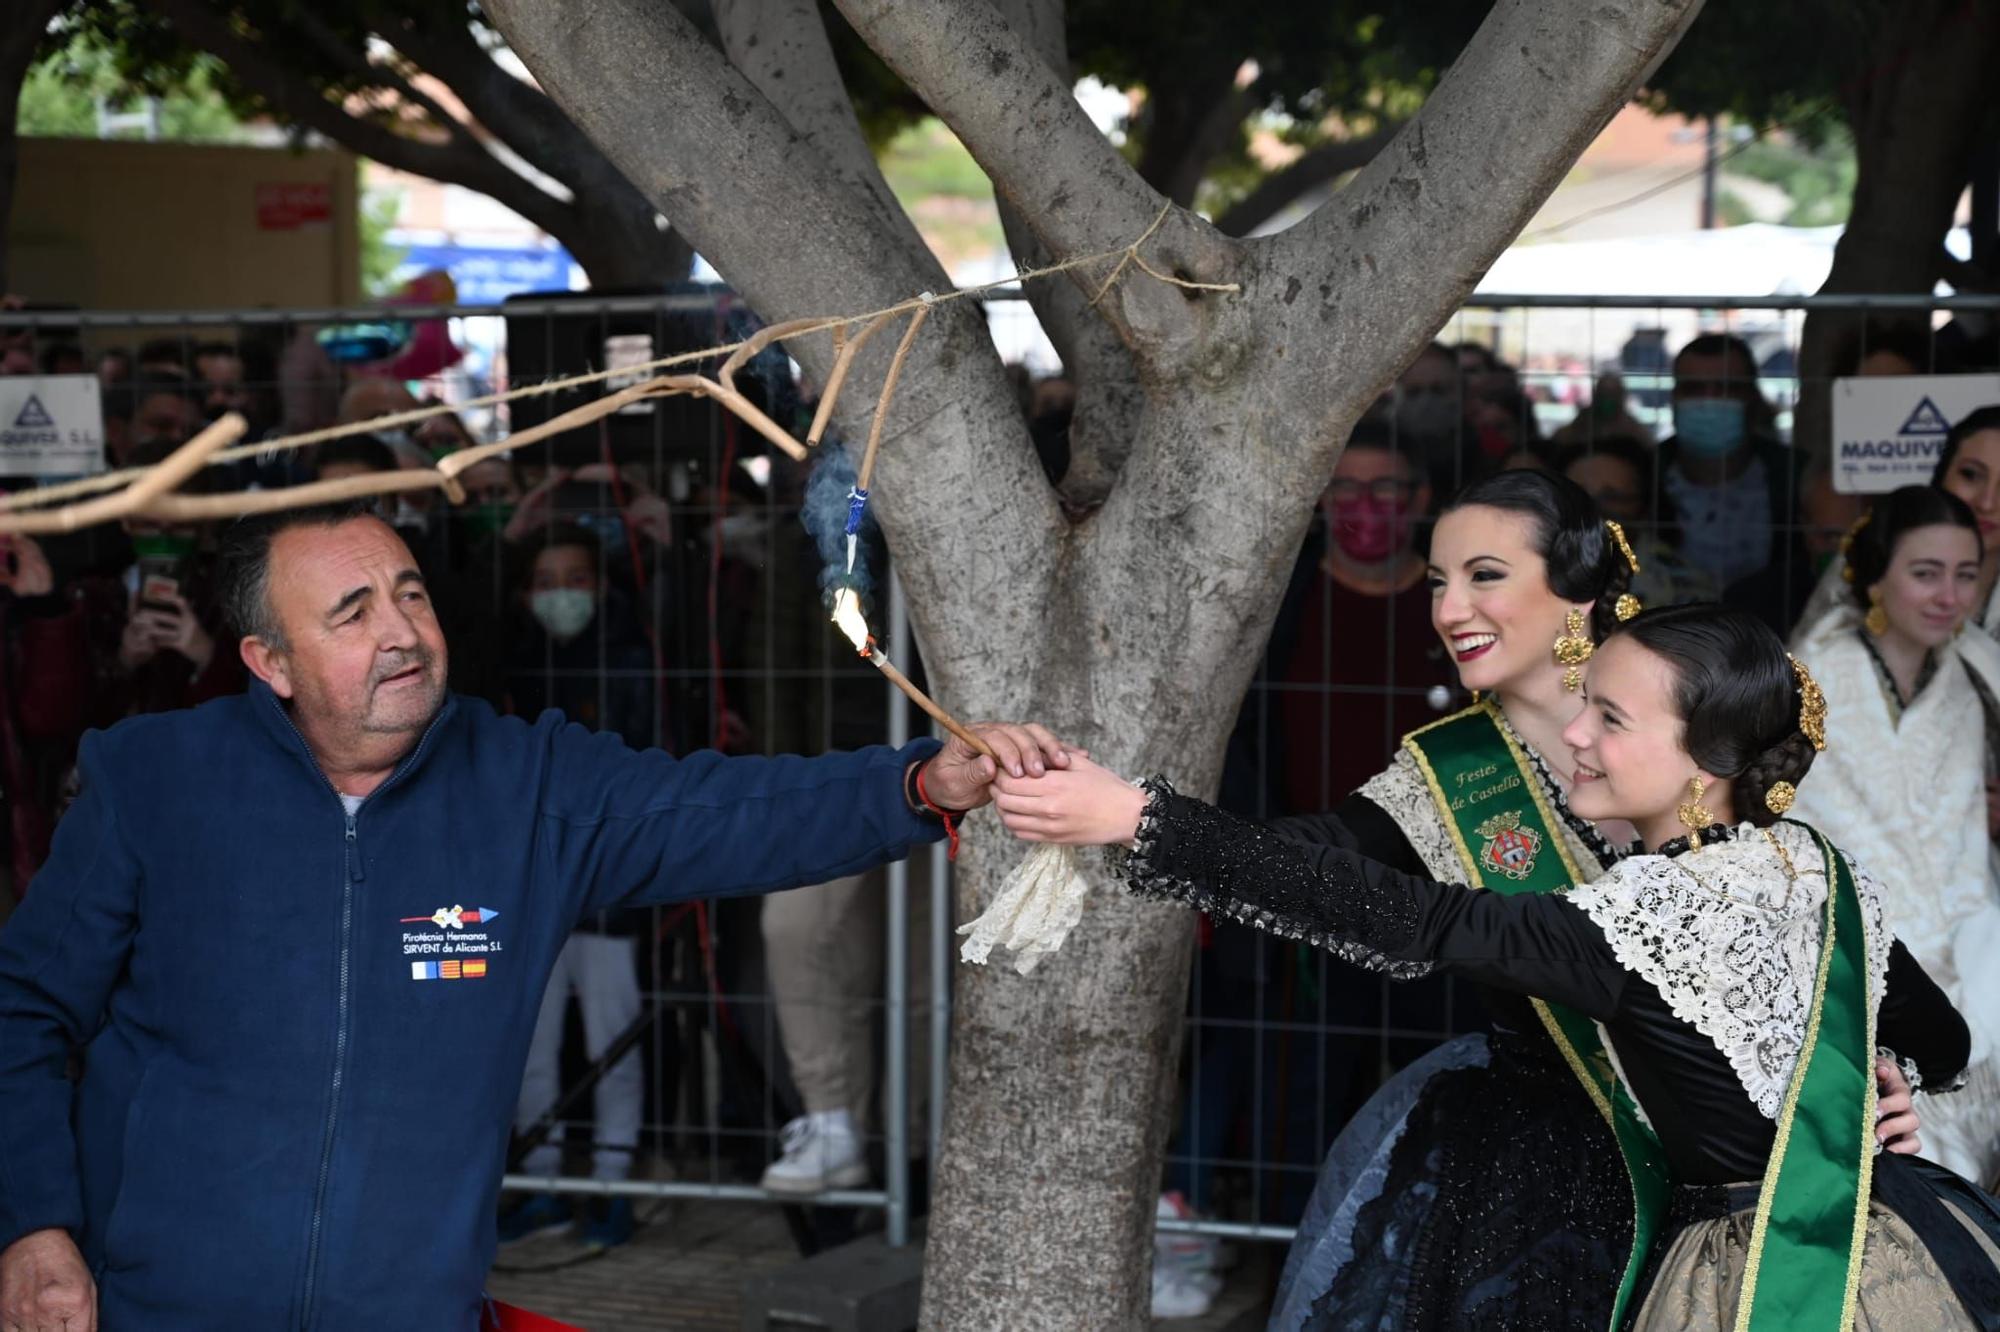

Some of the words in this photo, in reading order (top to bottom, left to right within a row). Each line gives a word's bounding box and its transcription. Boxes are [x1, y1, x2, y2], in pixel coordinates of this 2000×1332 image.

[1456, 764, 1497, 787] Festes
[1451, 797, 1466, 812] de
[1469, 774, 1521, 804] Castelló
[446, 931, 487, 941] Hermanos
[403, 943, 441, 954] SIRVENT
[442, 942, 453, 953] de
[455, 941, 489, 952] Alicante
